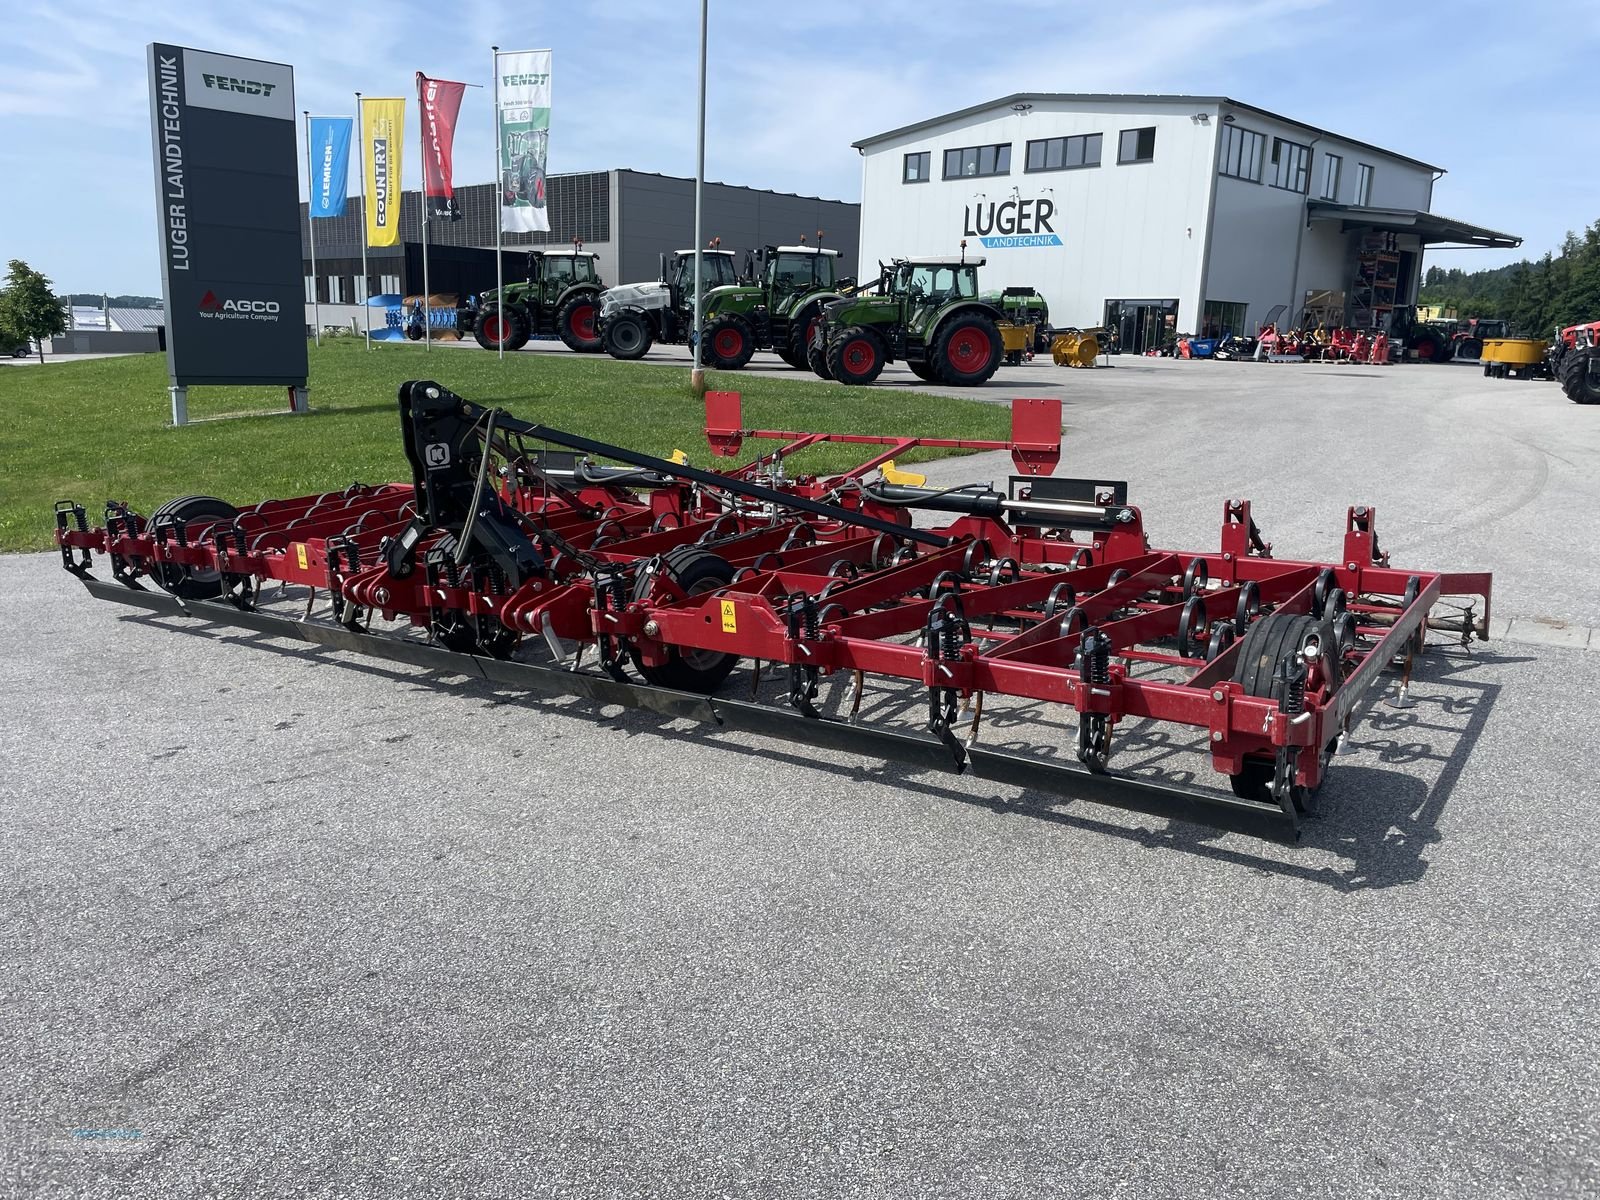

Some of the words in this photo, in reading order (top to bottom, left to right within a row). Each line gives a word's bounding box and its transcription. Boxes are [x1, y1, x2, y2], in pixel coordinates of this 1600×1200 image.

[202, 73, 276, 97] FENDT
[502, 74, 550, 87] FENDT
[160, 55, 184, 198] LANDTECHNIK
[322, 145, 333, 197] LEMKEN
[375, 141, 386, 225] COUNTRY
[964, 199, 1055, 236] LUGER
[170, 204, 189, 270] LUGER
[987, 236, 1054, 248] LANDTECHNIK
[214, 312, 249, 320] Agriculture
[250, 313, 279, 322] Company
[223, 299, 280, 313] AGCO
